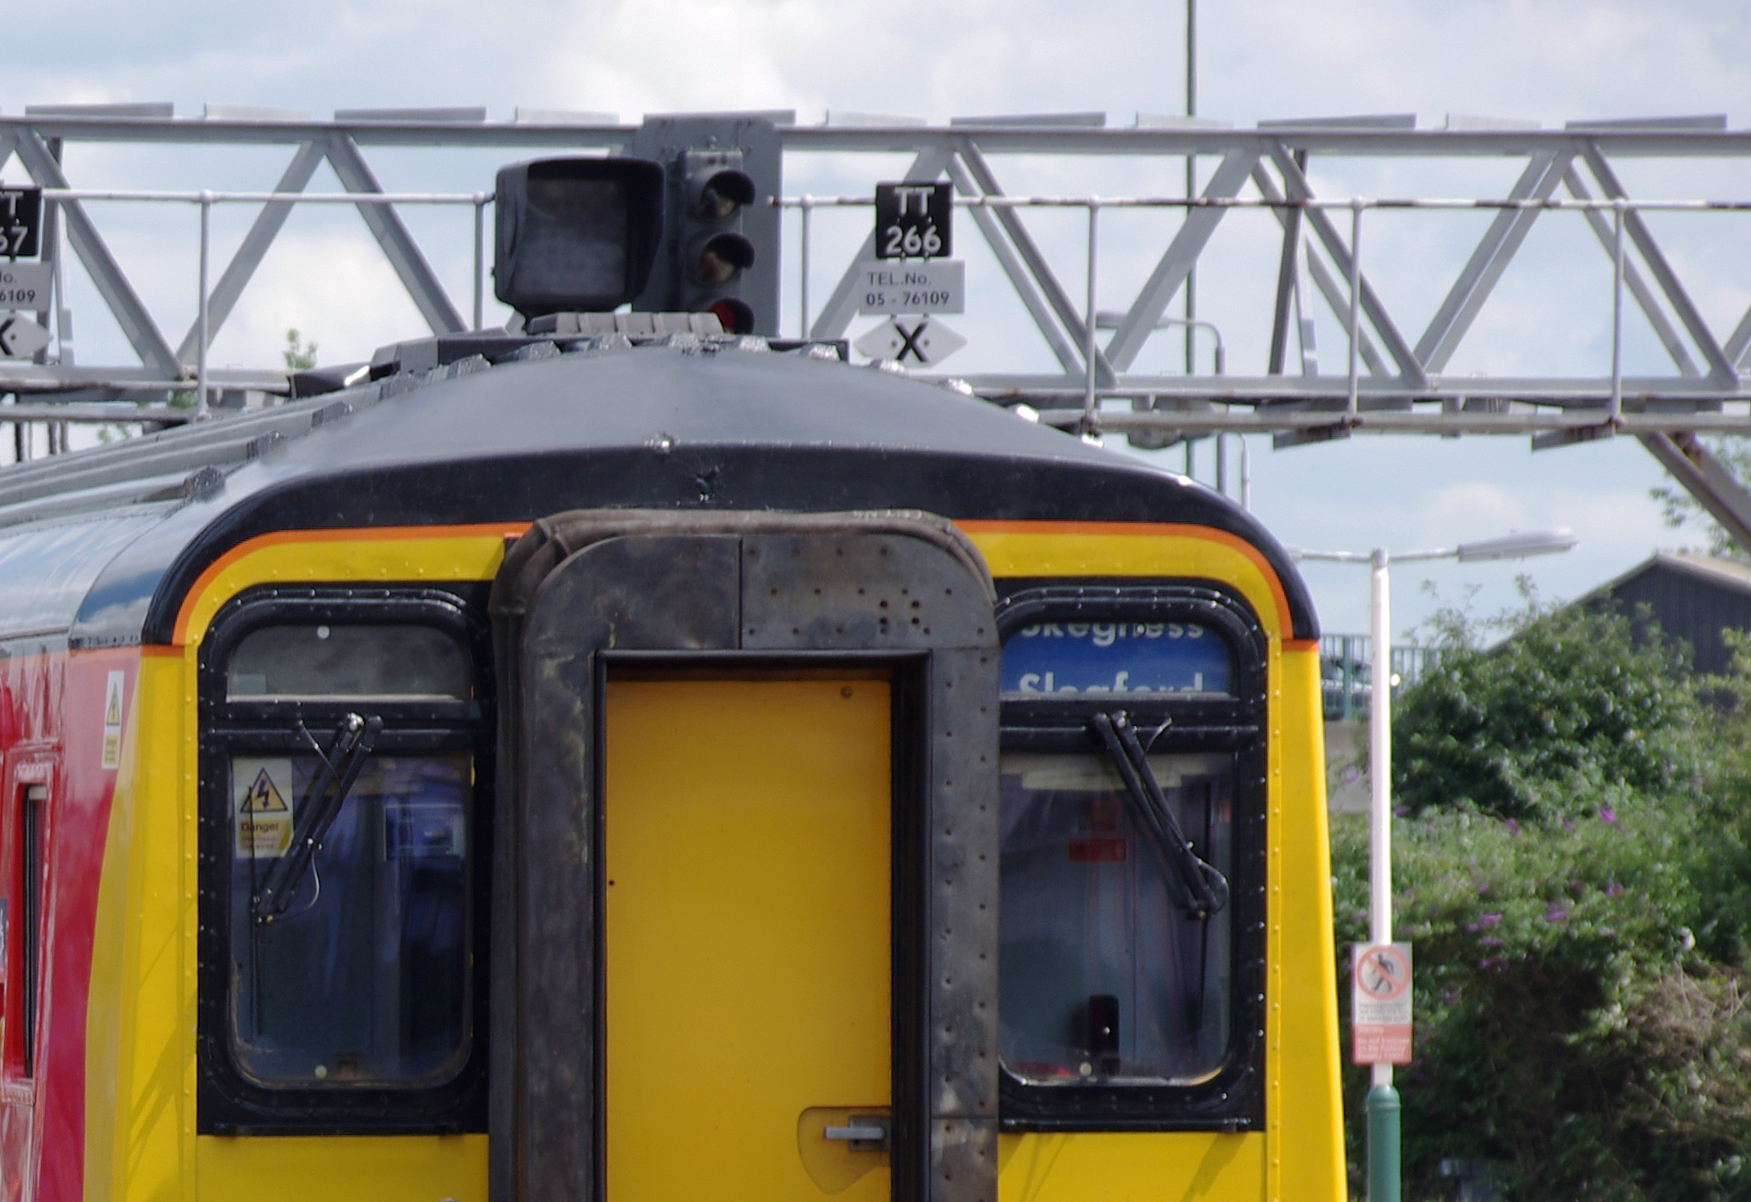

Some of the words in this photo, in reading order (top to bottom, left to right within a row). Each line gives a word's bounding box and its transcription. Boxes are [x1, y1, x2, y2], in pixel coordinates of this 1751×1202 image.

[894, 187, 935, 215] TT
[886, 225, 942, 255] 266
[903, 291, 950, 306] 76109
[894, 322, 929, 363] X
